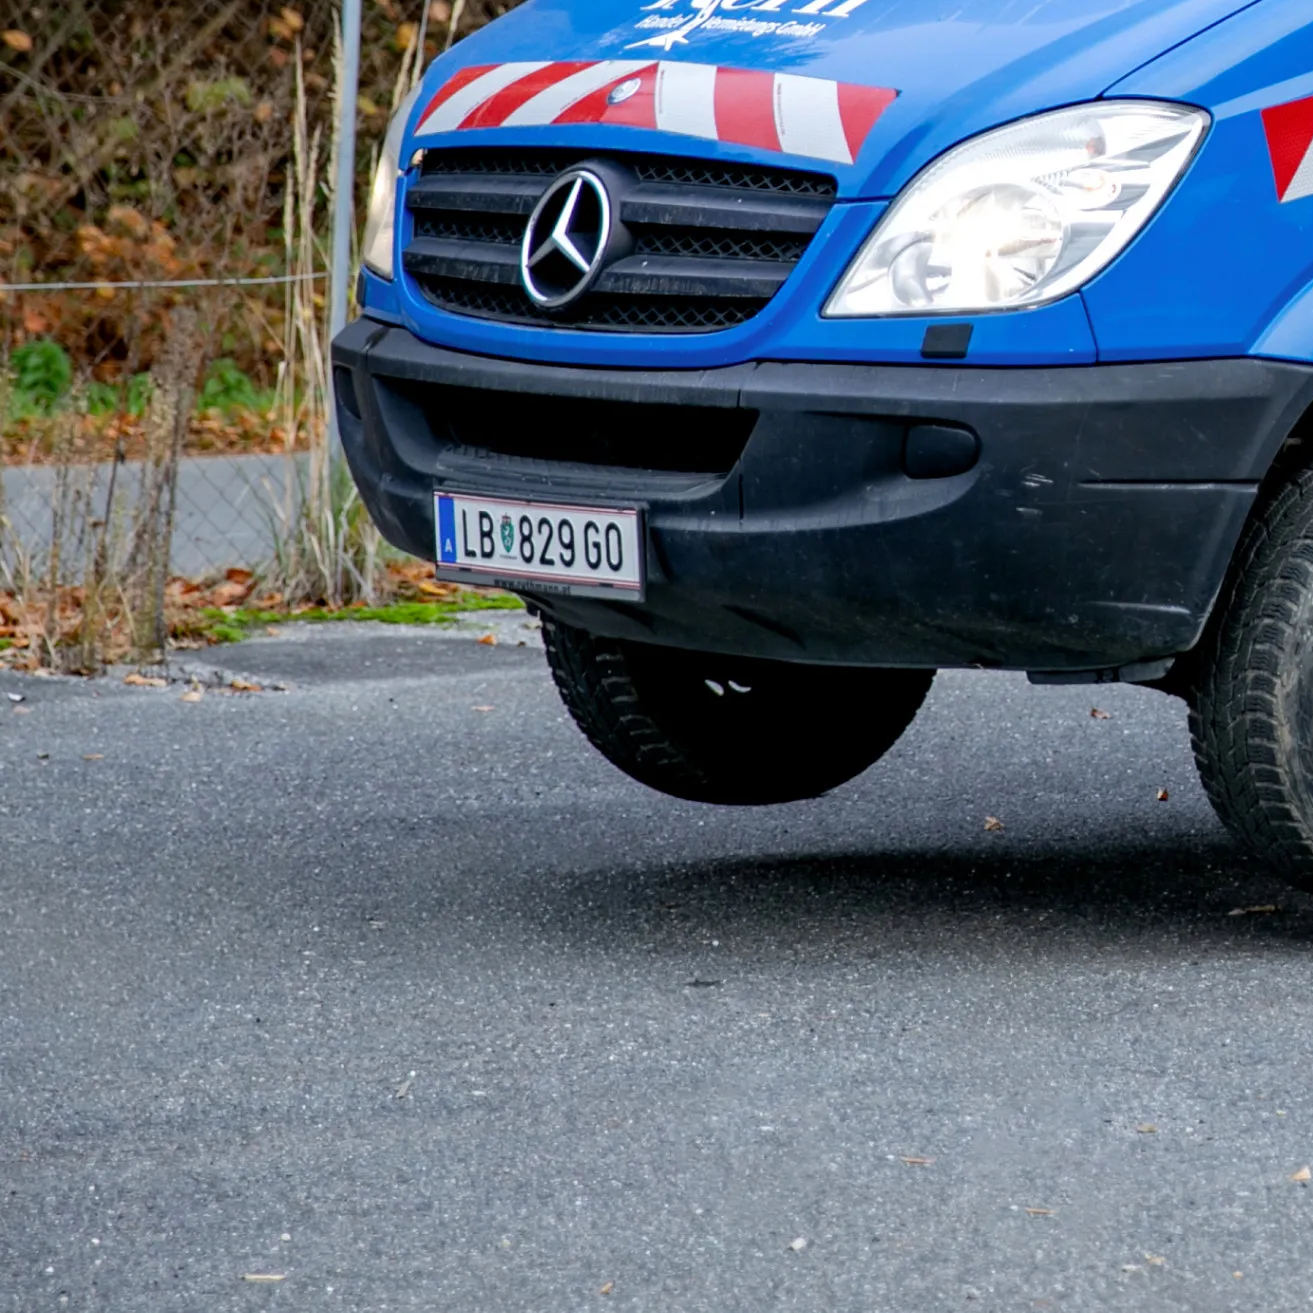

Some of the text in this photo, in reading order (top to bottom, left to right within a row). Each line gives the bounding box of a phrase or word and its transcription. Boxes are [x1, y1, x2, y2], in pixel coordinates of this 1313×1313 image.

[444, 539, 453, 553] A
[462, 509, 495, 559] LB
[519, 515, 576, 568] 829
